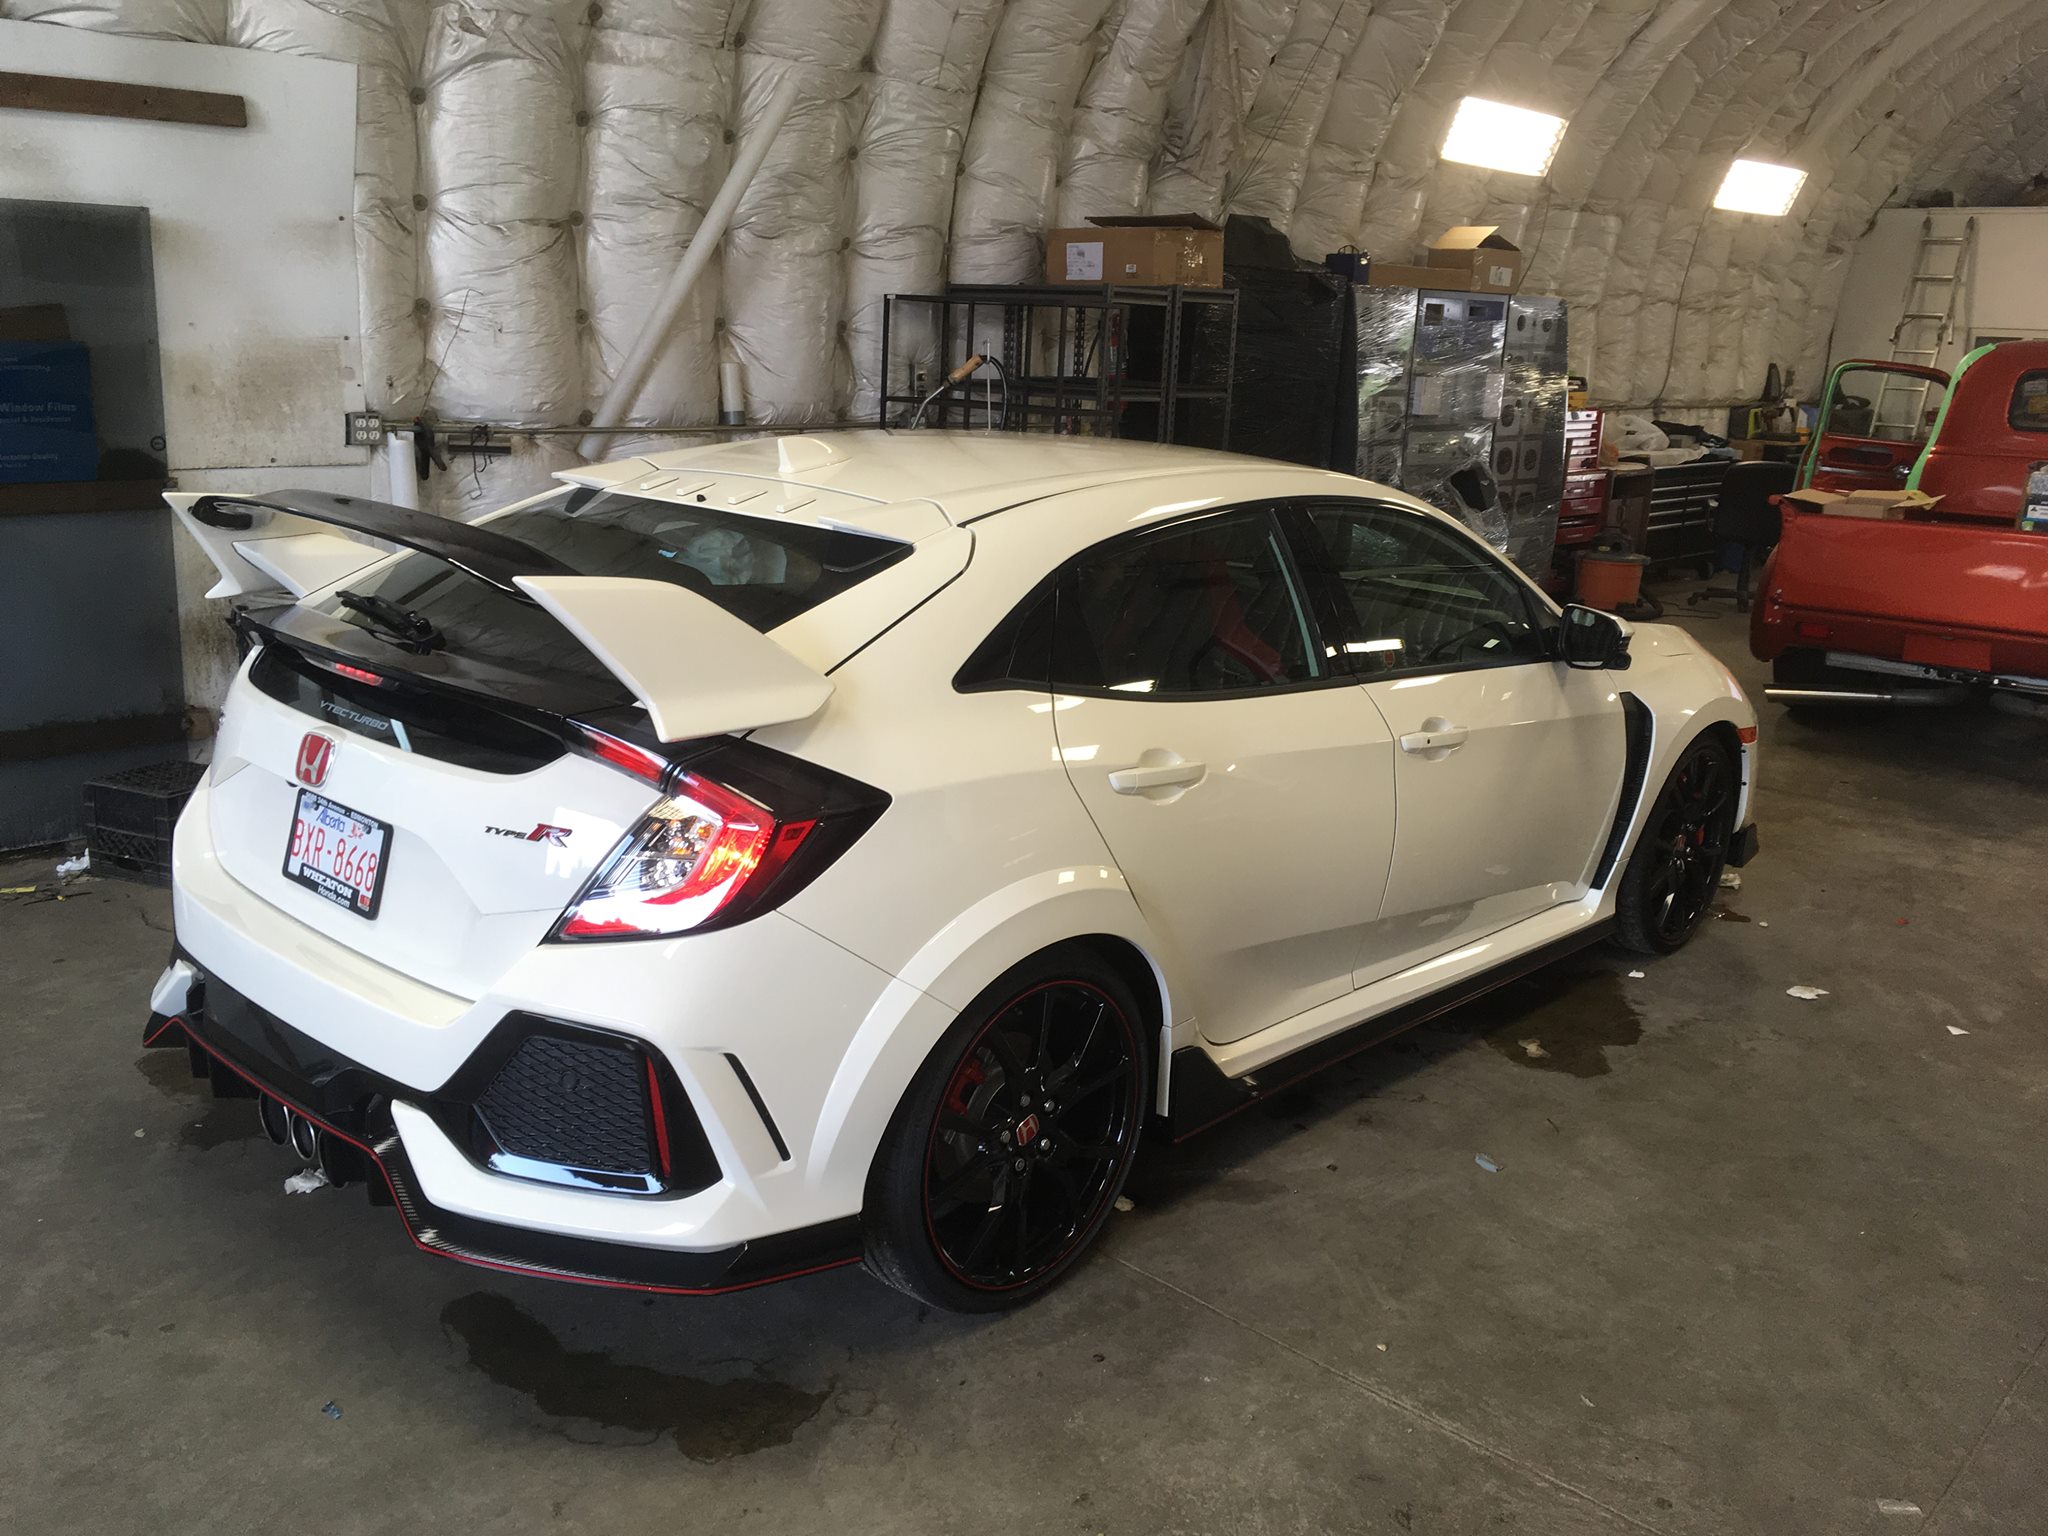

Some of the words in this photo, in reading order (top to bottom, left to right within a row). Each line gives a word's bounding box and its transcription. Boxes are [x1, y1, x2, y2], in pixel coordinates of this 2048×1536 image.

[47, 401, 77, 413] Films
[316, 808, 345, 833] Alberta
[485, 825, 527, 840] TYPE
[526, 823, 573, 848] R
[291, 818, 377, 892] BXR-8668
[303, 866, 353, 899] WHEATON
[317, 885, 351, 908] Honda.com
